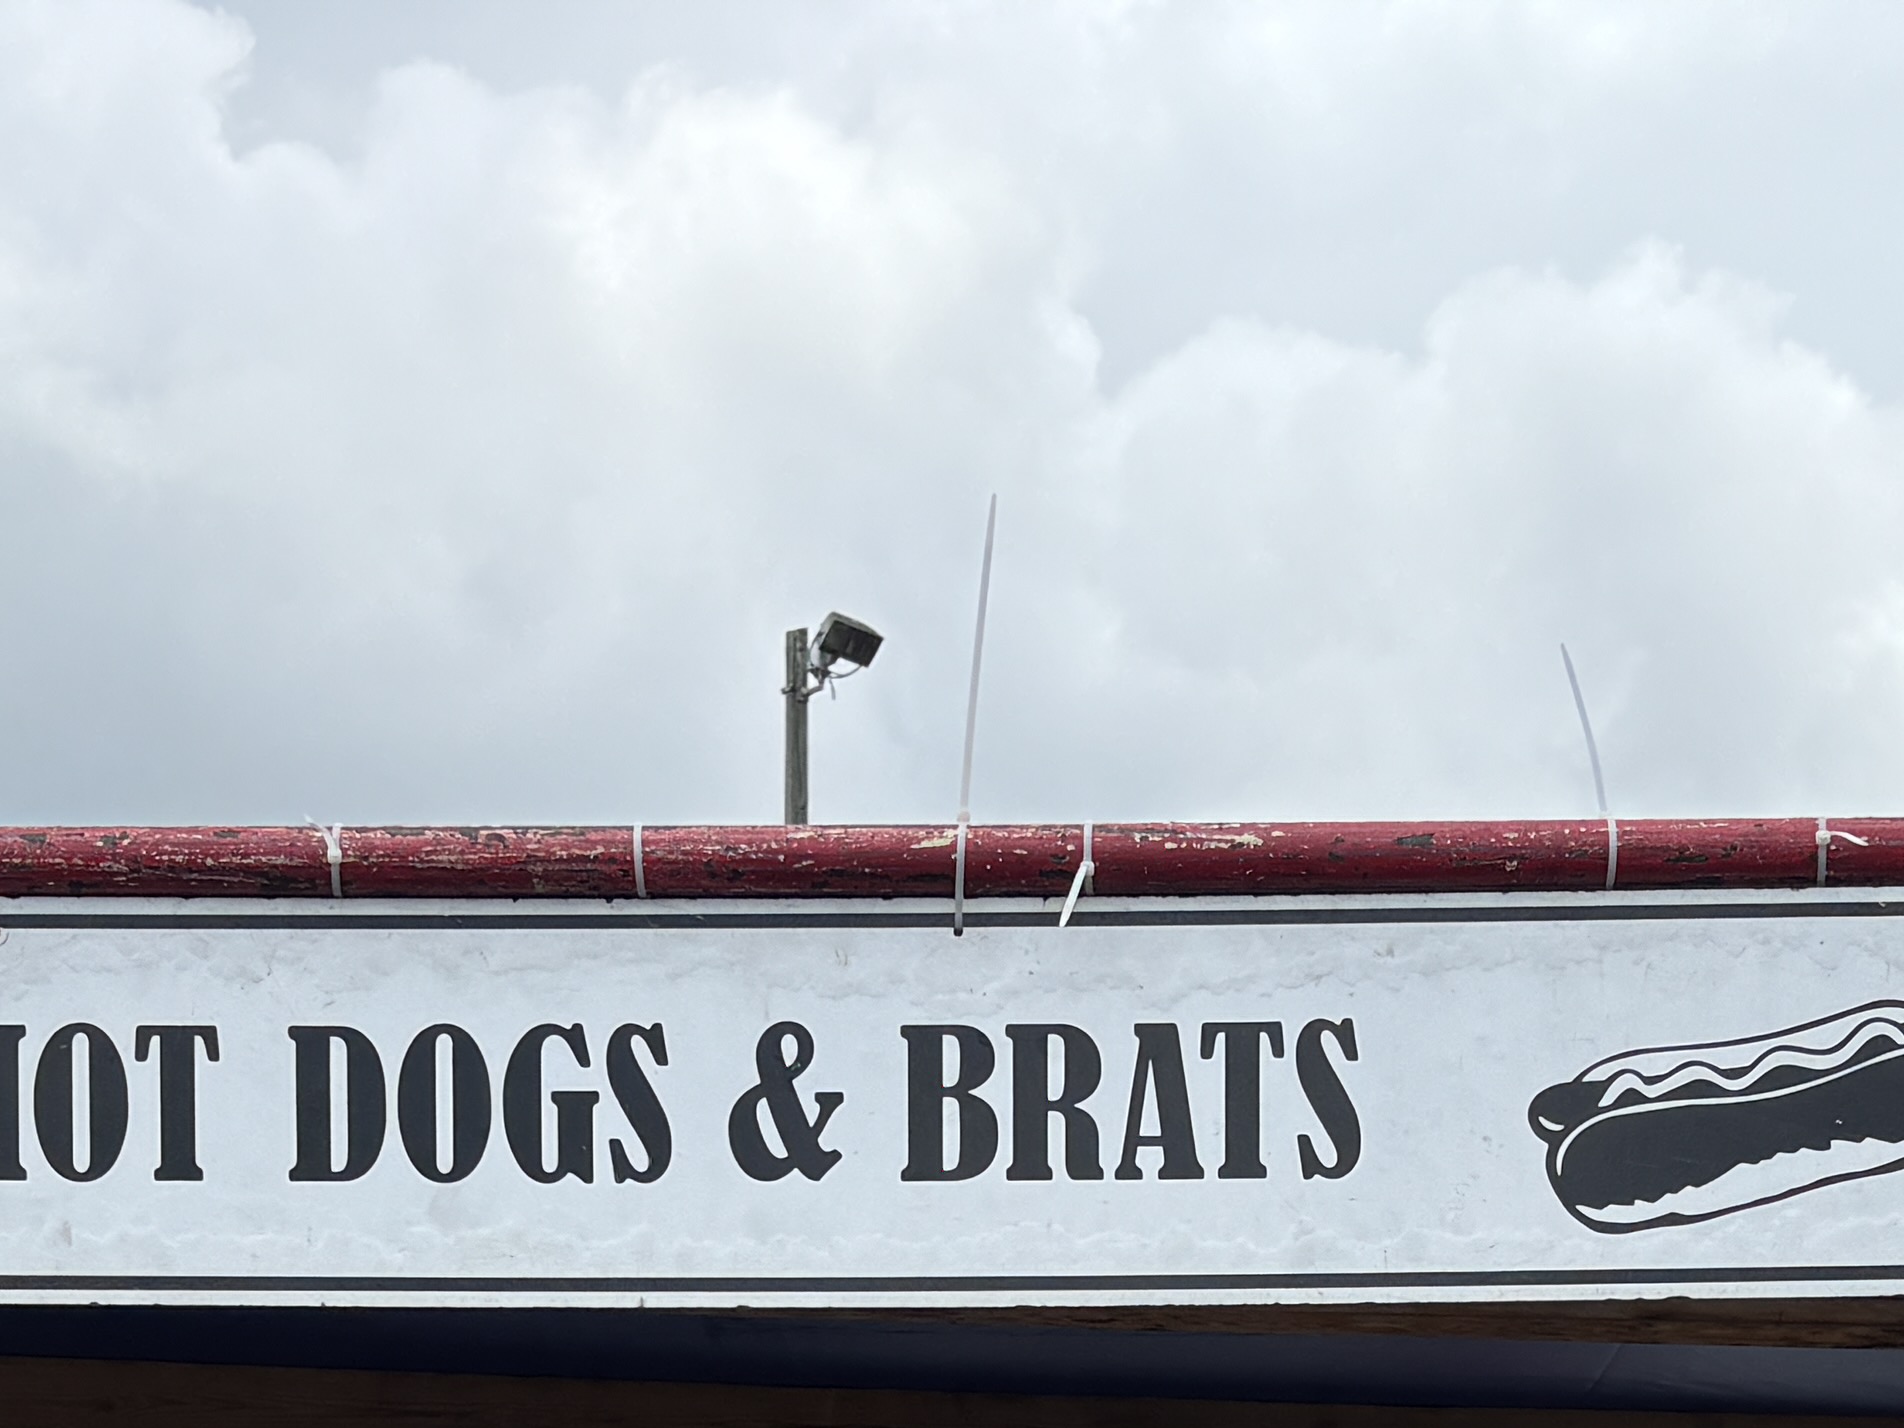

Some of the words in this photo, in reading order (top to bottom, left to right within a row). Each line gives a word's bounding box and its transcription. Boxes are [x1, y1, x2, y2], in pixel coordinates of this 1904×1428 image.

[285, 1021, 673, 1184] DOGS
[727, 1020, 844, 1184] &
[897, 1015, 1362, 1184] BRATS
